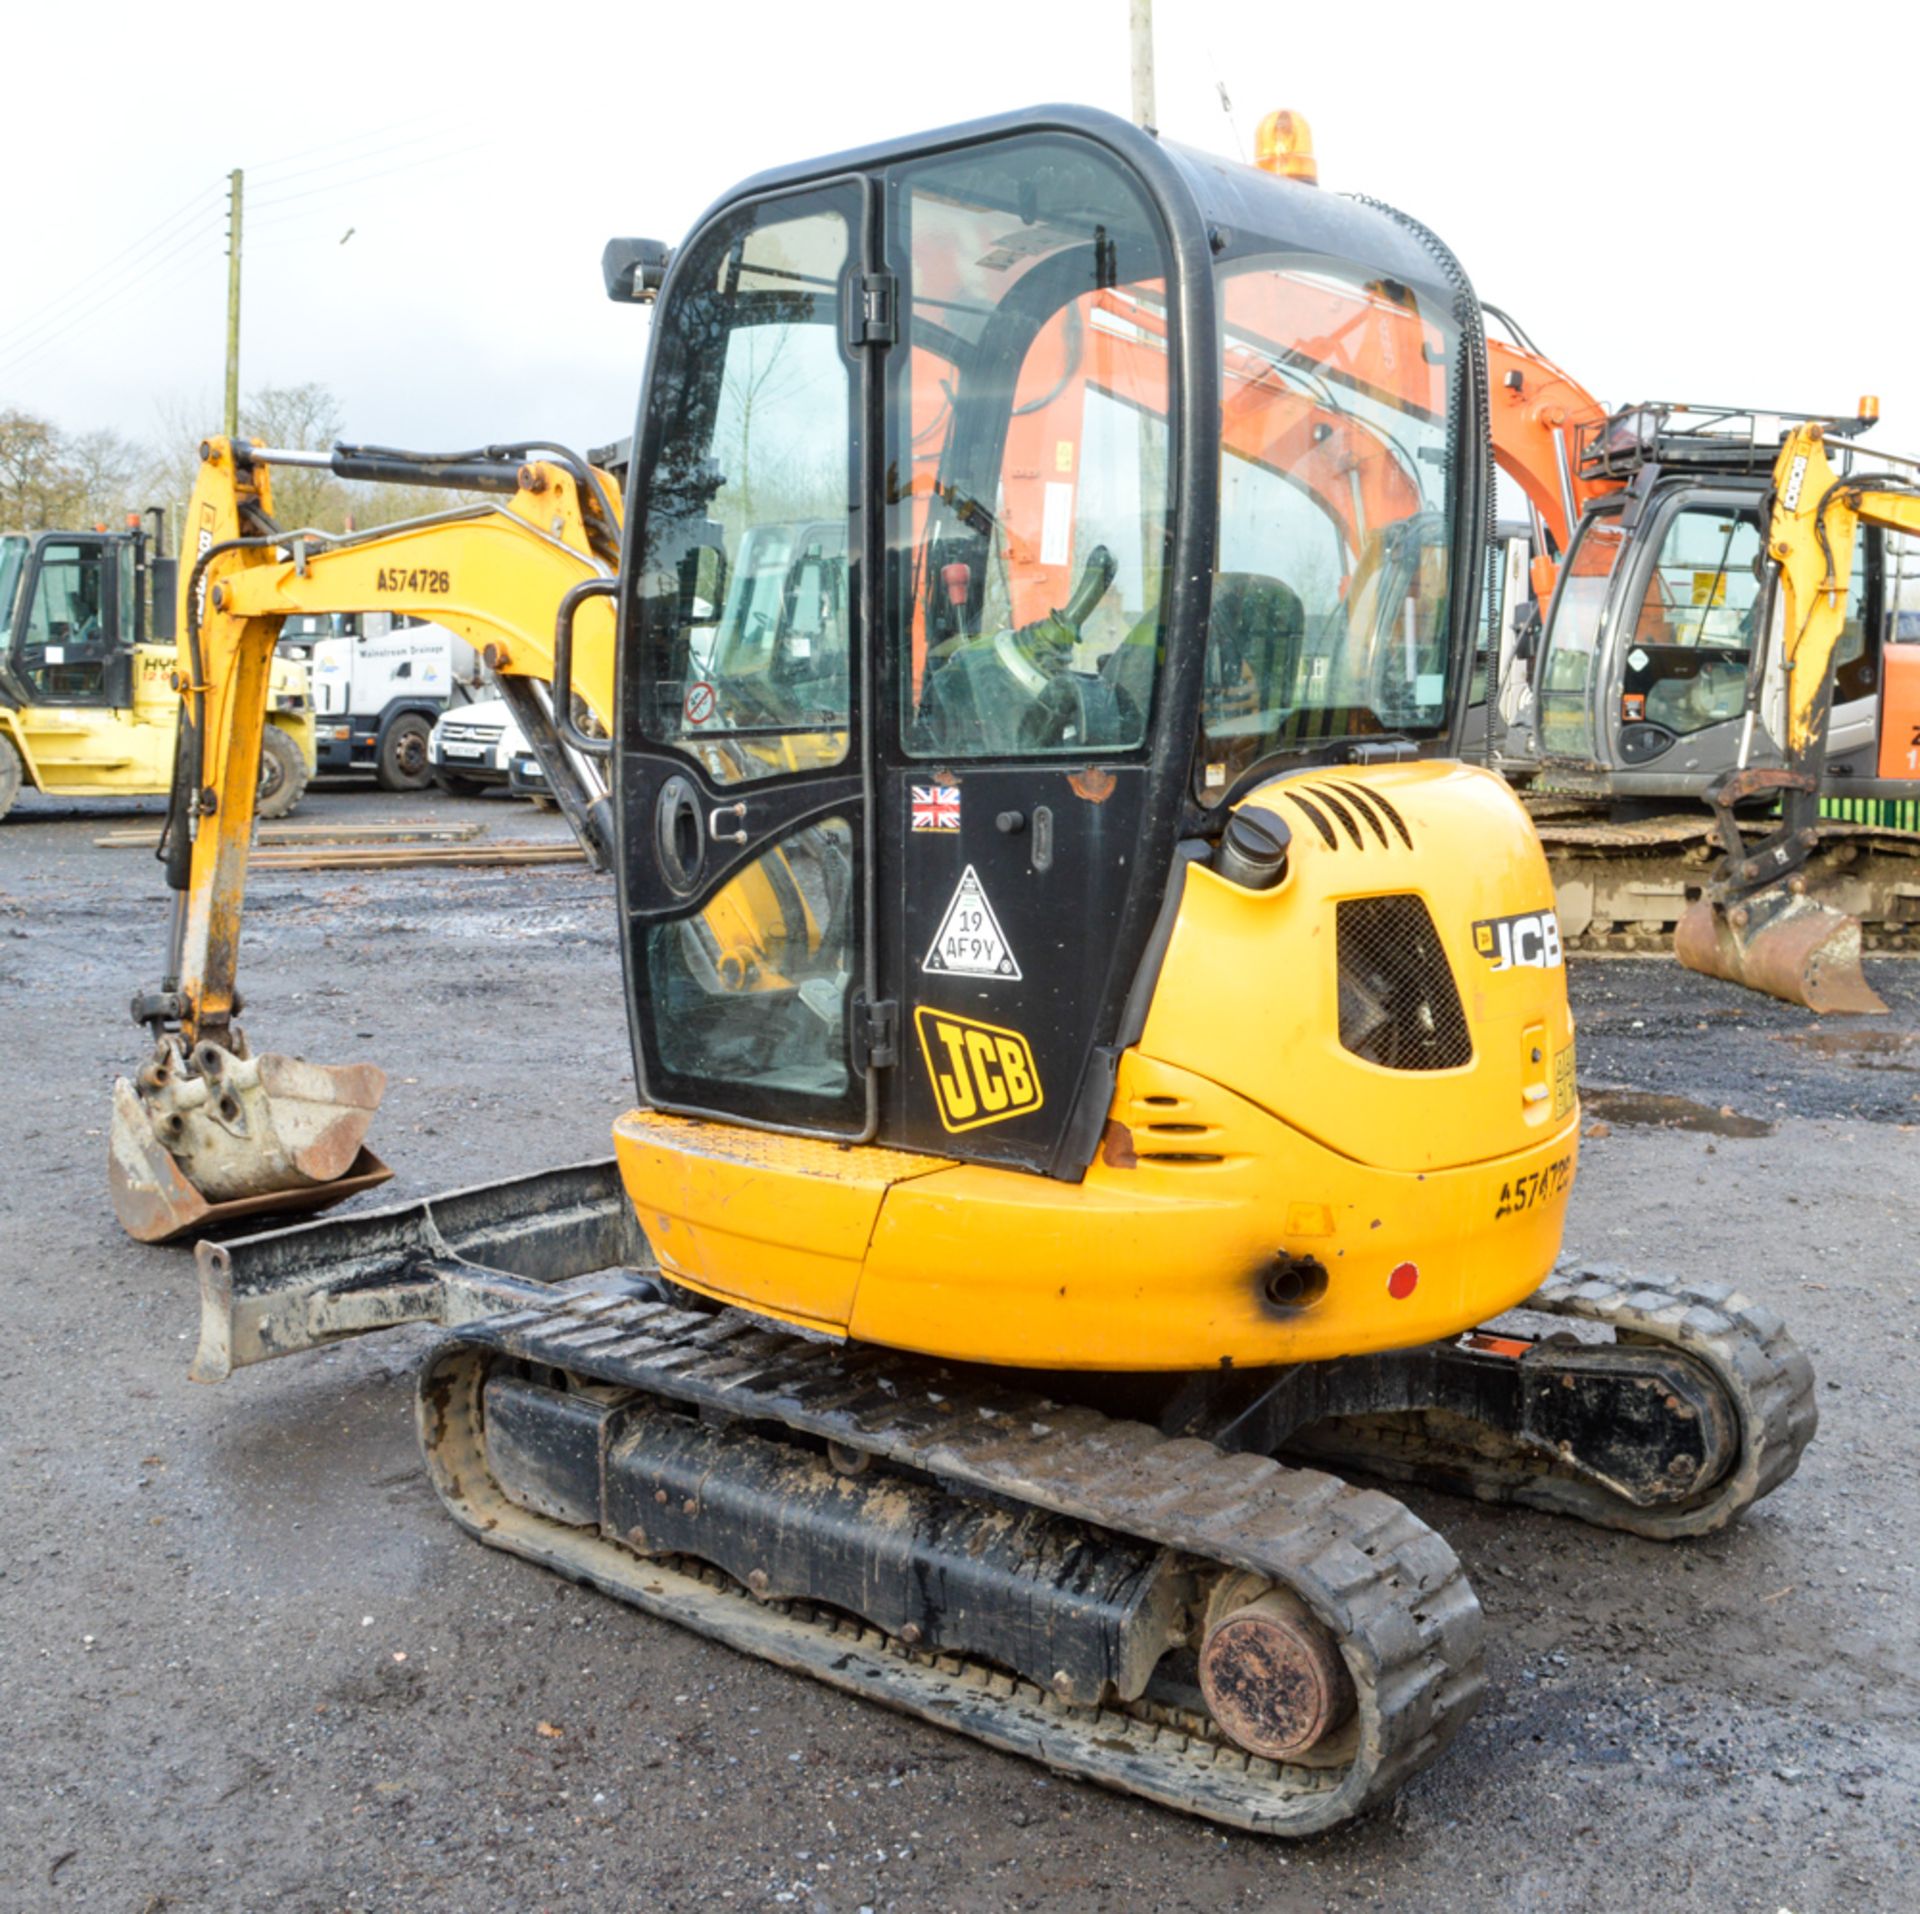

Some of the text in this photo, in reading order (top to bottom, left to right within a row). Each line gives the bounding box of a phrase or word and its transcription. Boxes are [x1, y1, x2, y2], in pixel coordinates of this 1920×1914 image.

[376, 567, 450, 594] A574726
[359, 645, 443, 659] Mainstream Drainage
[959, 910, 983, 933] 19
[946, 936, 995, 961] AF9Y
[1489, 911, 1563, 973] JCB
[936, 1020, 1034, 1119] JCB
